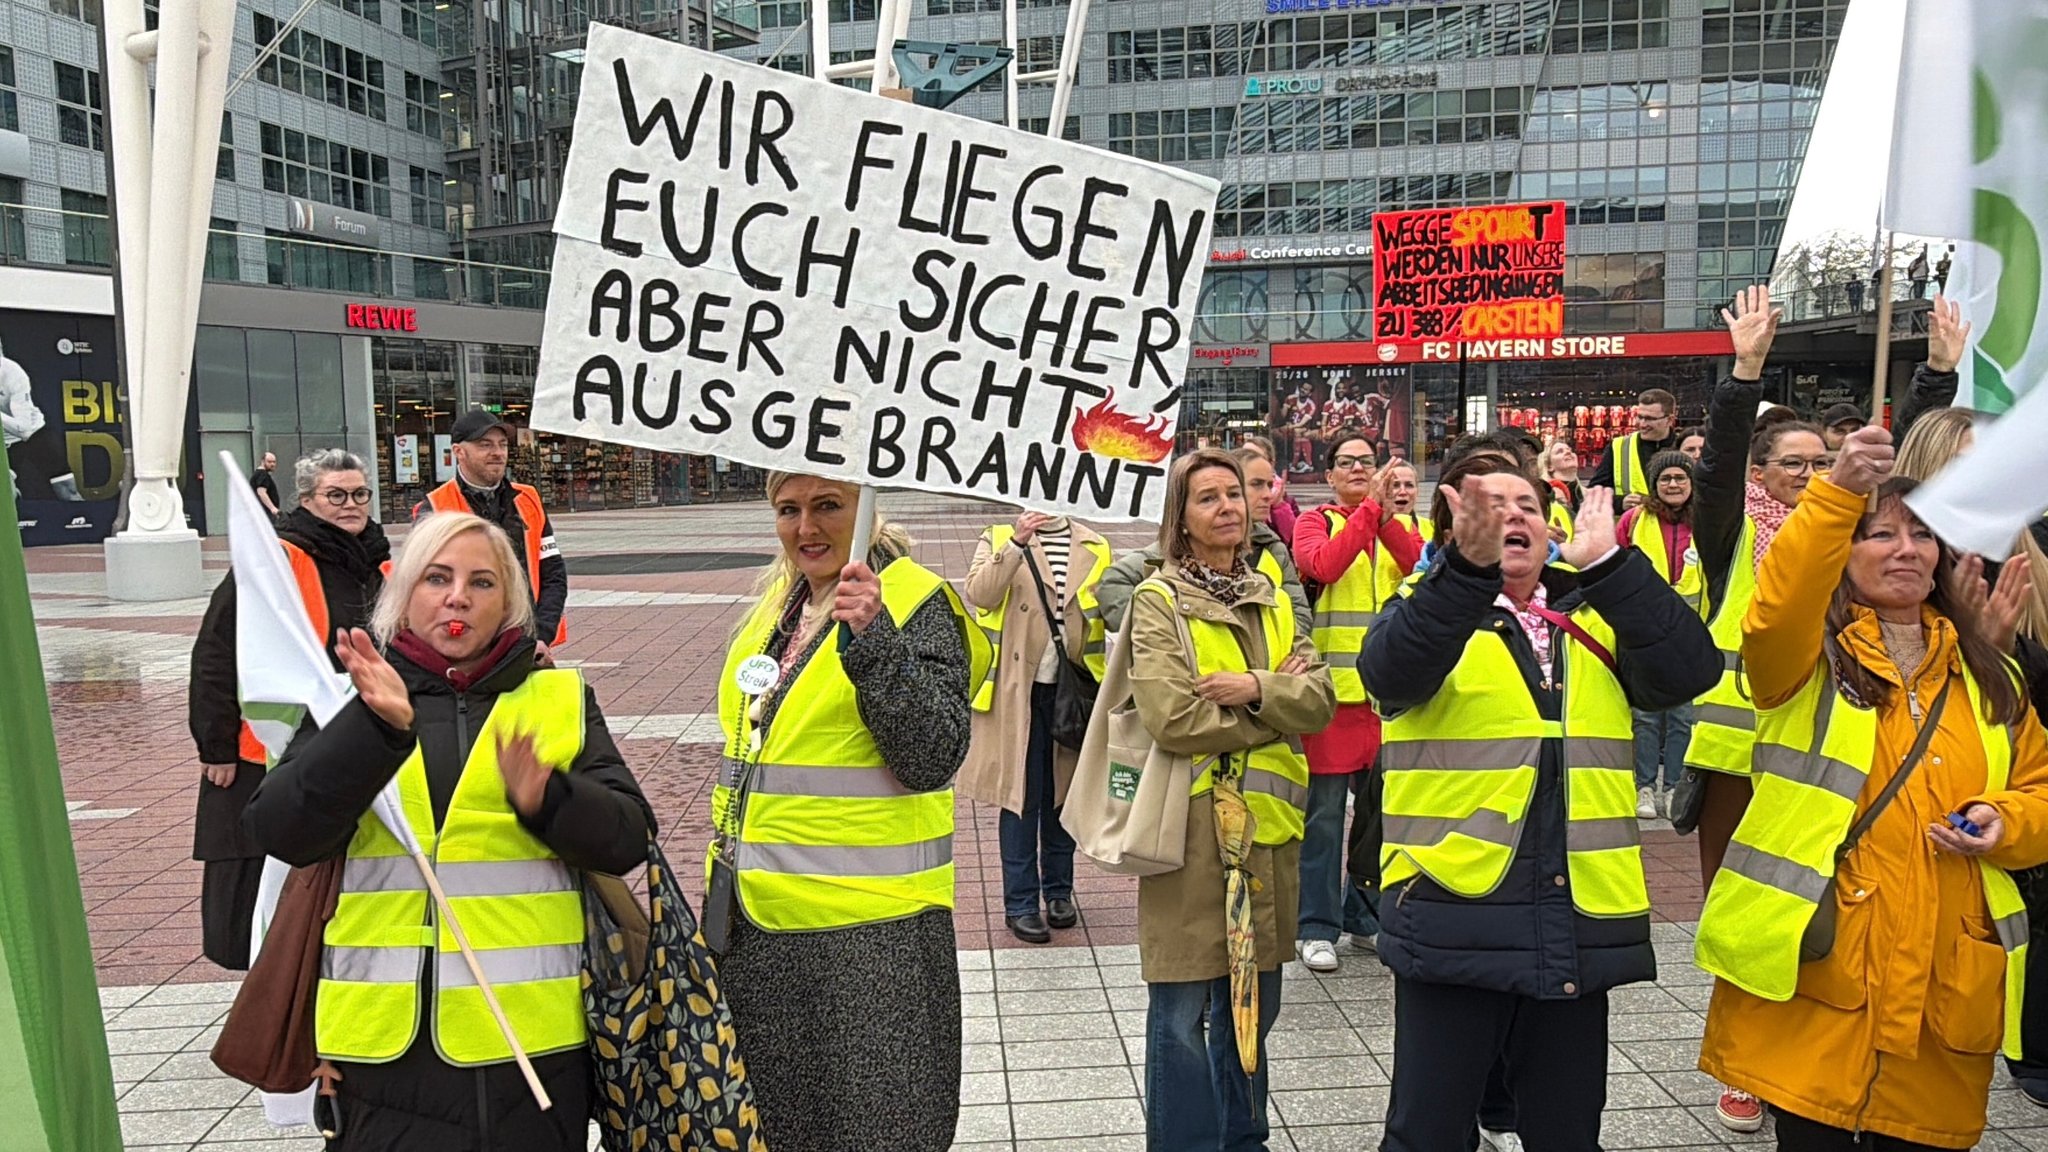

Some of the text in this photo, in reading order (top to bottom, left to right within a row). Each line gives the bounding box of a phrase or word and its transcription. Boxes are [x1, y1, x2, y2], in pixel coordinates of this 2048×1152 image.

[613, 58, 1206, 309] WIR FLIEGEN
[335, 216, 366, 235] Forum
[601, 168, 861, 309] EUCH
[1251, 245, 1341, 259] Conference
[1382, 241, 1565, 281] WERDEN NUR UNSERE
[346, 303, 417, 332] REWE
[1378, 310, 1404, 338] ZU
[1461, 302, 1563, 337] CARSTEN
[589, 268, 1107, 445] ABER NICHT
[1422, 342, 1450, 359] FC
[1551, 336, 1626, 355] STORE
[1275, 367, 1406, 381] 25/26 HOME JERSEY
[573, 354, 1164, 517] AUSGEBRANNT
[738, 670, 770, 688] Streik
[749, 659, 775, 673] UFO
